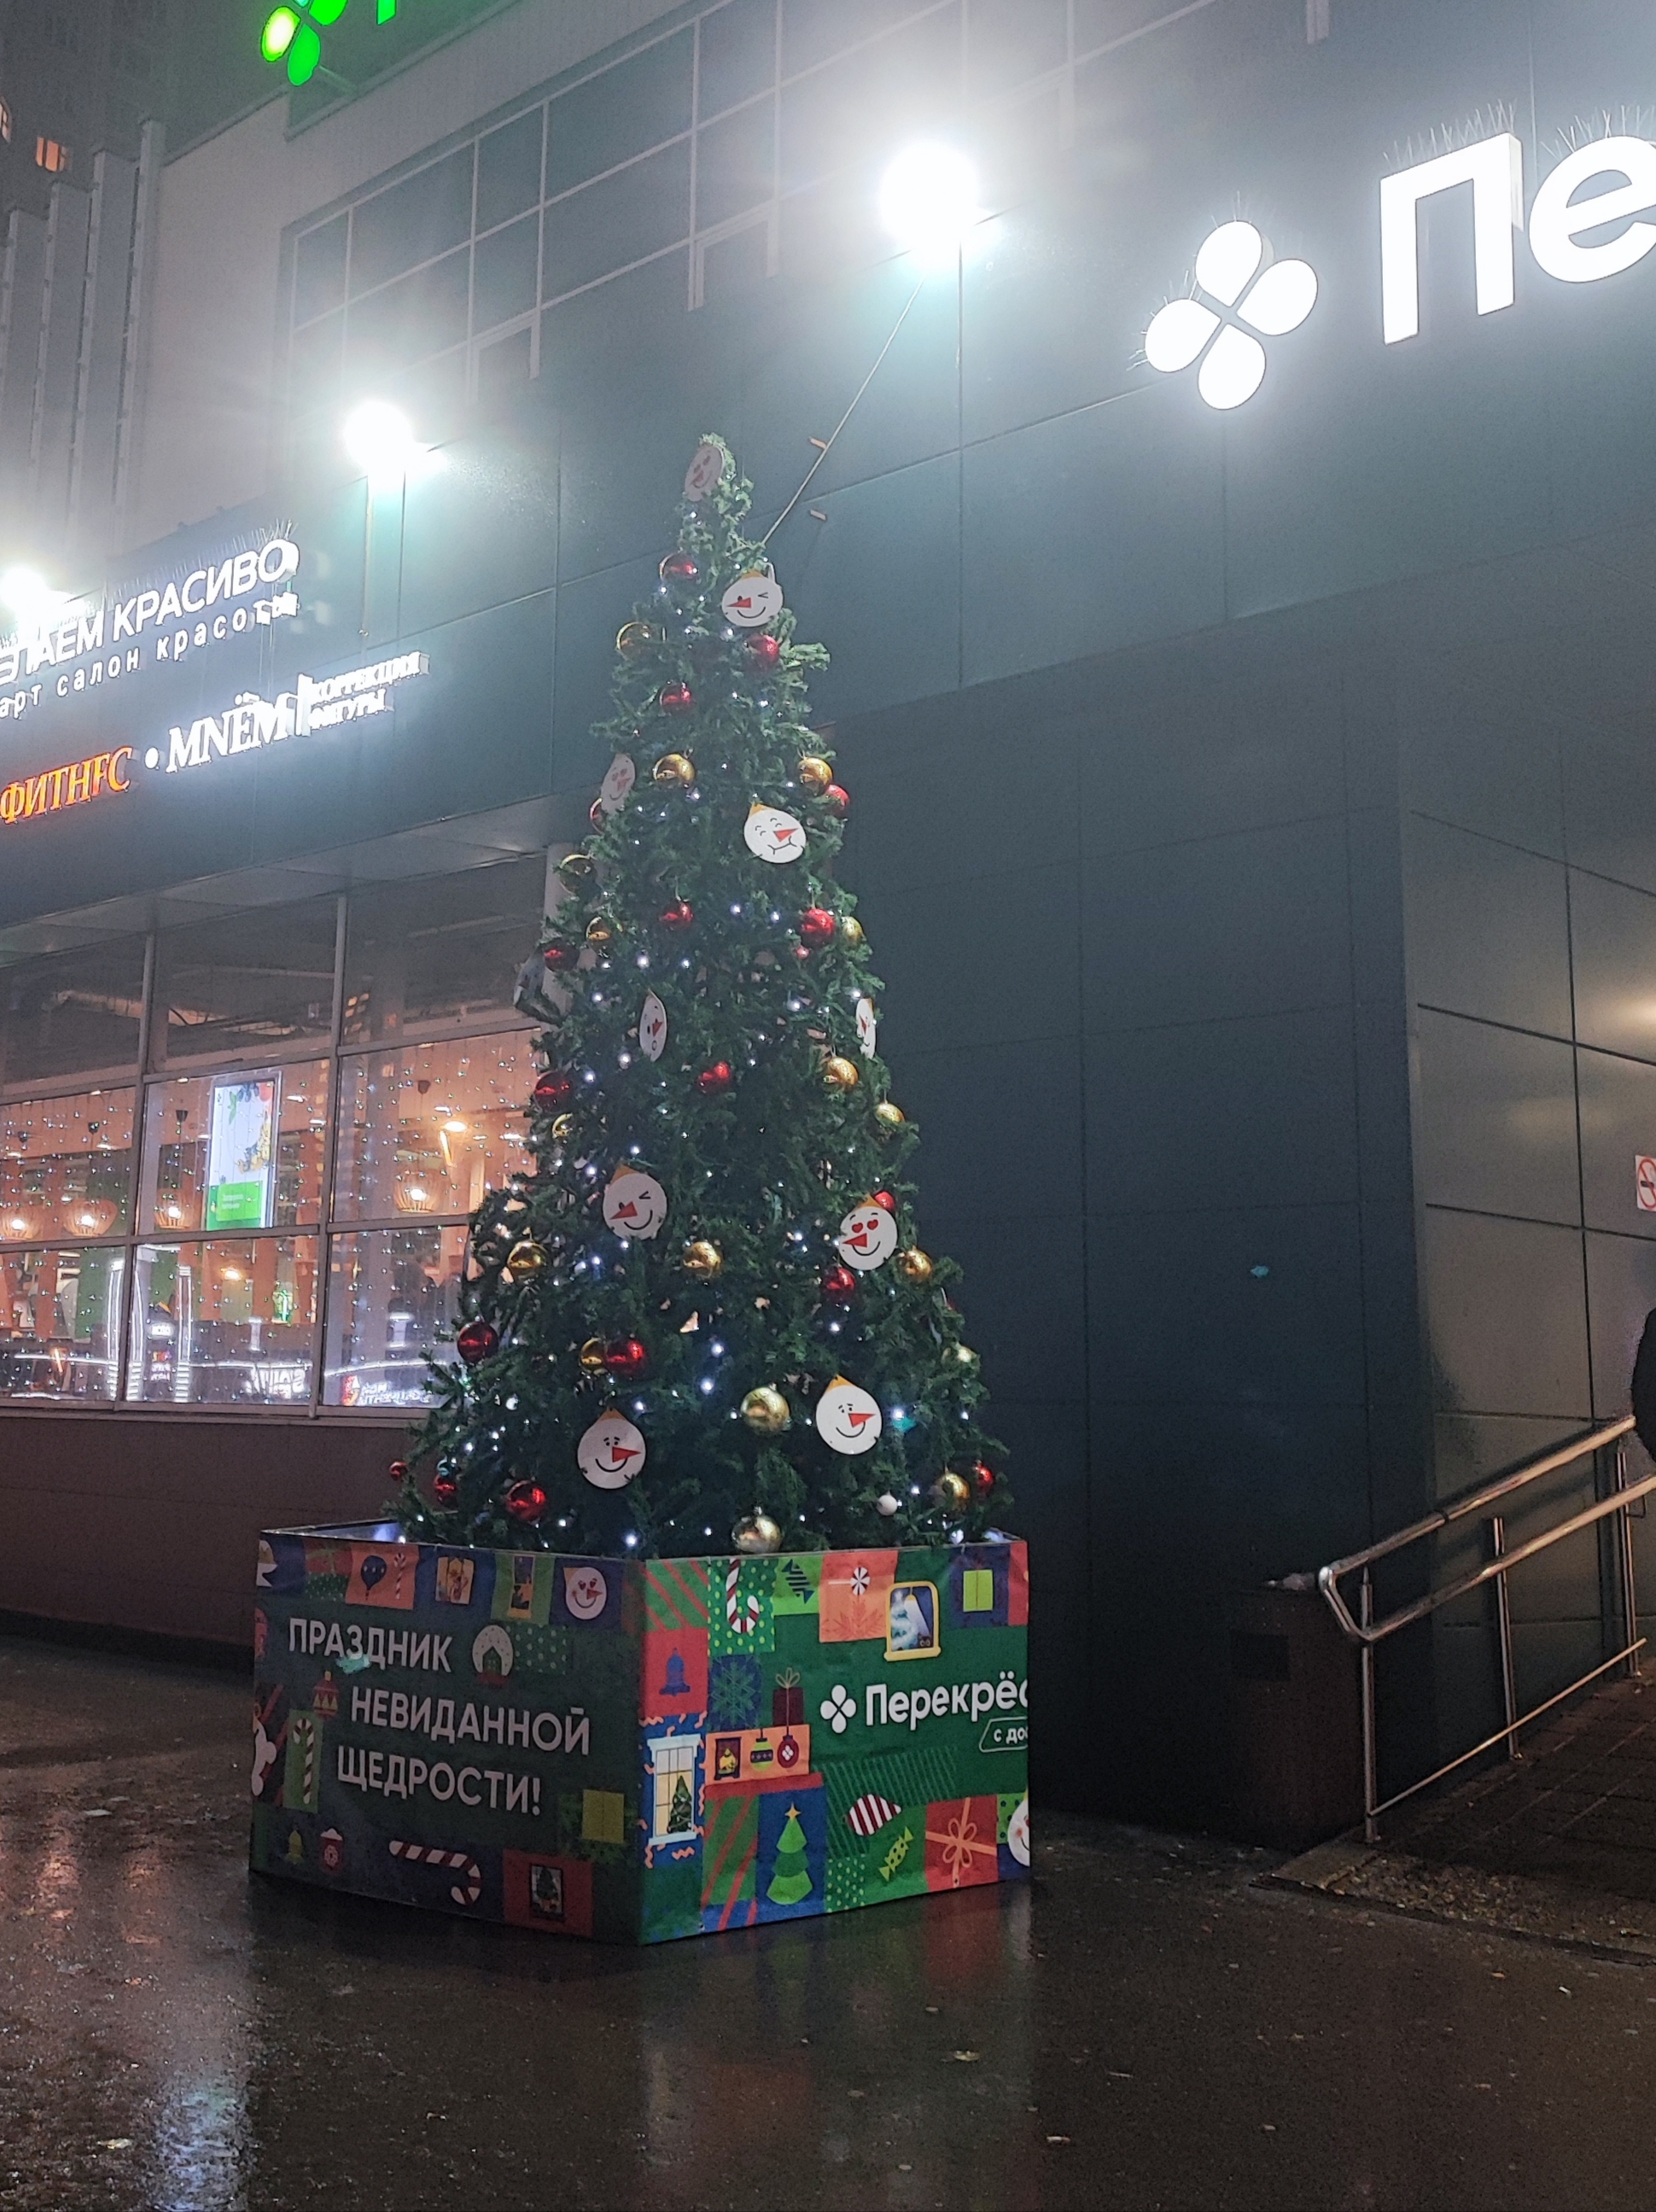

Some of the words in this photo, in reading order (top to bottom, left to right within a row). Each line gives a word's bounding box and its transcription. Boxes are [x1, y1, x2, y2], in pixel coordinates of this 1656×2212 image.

[113, 539, 300, 642] КРАСИВО
[56, 646, 140, 697] салон
[156, 592, 299, 662] красоты
[289, 1617, 452, 1672] ПРАЗДНИК
[351, 1686, 590, 1756] НЕВИДАННОЙ
[993, 1728, 1002, 1742] с
[337, 1745, 541, 1816] ЩЕДРОСТИ!
